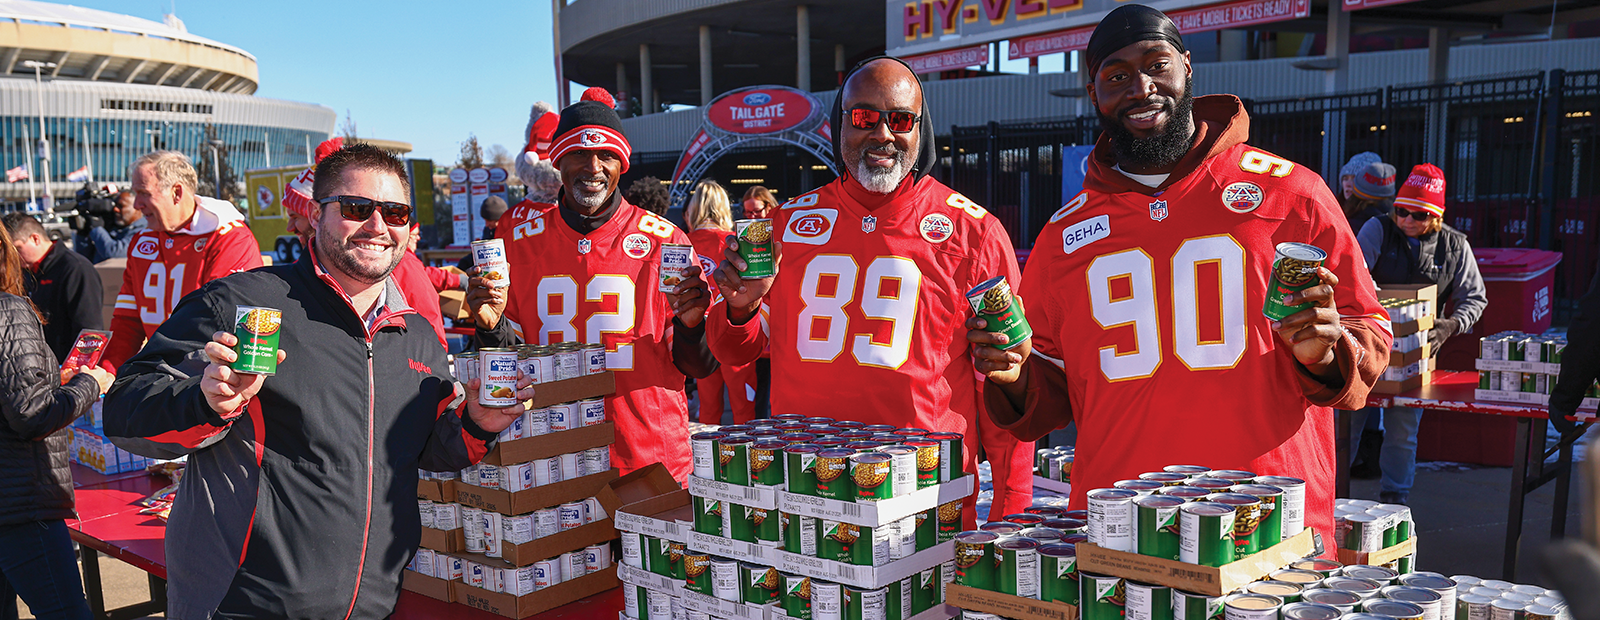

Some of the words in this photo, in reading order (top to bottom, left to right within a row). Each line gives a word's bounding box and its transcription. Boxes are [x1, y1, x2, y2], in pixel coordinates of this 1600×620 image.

[1182, 14, 1200, 29] HAVE
[1202, 8, 1229, 26] MOBILE
[1231, 3, 1262, 22] TICKETS
[1264, 0, 1289, 18] READY
[730, 103, 785, 120] TAILGATE
[746, 94, 769, 104] Ford
[743, 119, 772, 128] DISTRICT
[1064, 221, 1108, 247] GEHA.
[140, 261, 186, 325] 91
[537, 274, 636, 371] 82
[797, 253, 922, 370] 89
[1086, 233, 1248, 383] 90
